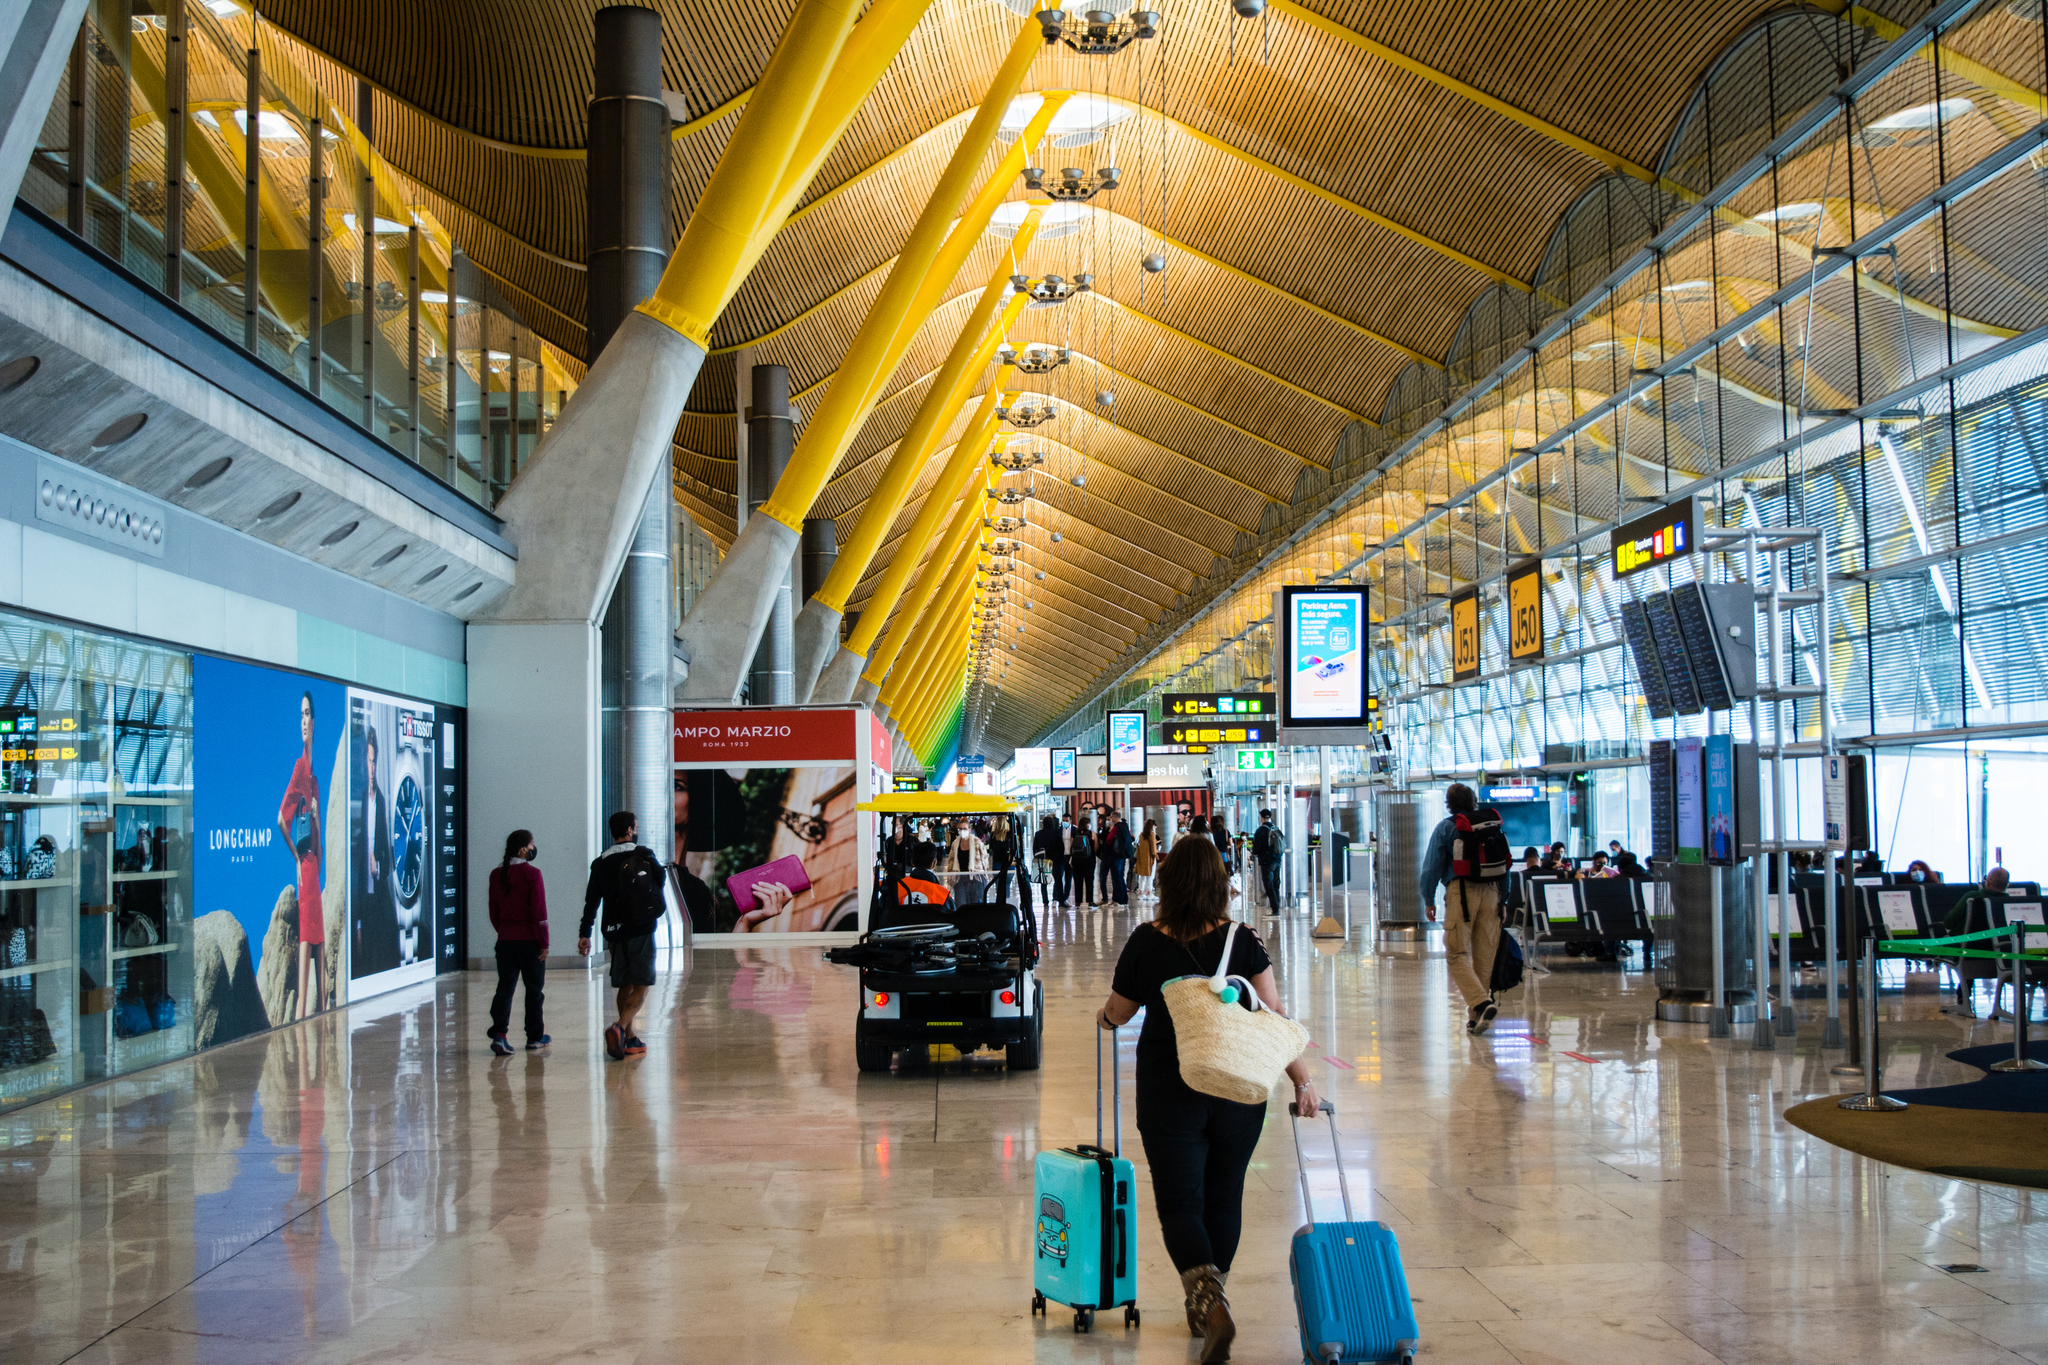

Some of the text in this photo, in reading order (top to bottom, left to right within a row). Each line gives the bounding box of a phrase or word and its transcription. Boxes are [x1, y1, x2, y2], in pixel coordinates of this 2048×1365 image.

[1676, 527, 1682, 546] K
[1301, 602, 1348, 610] Parking Aena,
[1514, 604, 1536, 649] J50
[1458, 626, 1474, 666] J51
[674, 726, 791, 737] AMPO MARZIO
[1228, 731, 1242, 739] J59
[1250, 731, 1257, 739] K
[1147, 763, 1188, 776] ass hut
[210, 828, 272, 850] LONGCHAMP
[231, 855, 253, 863] PARIS
